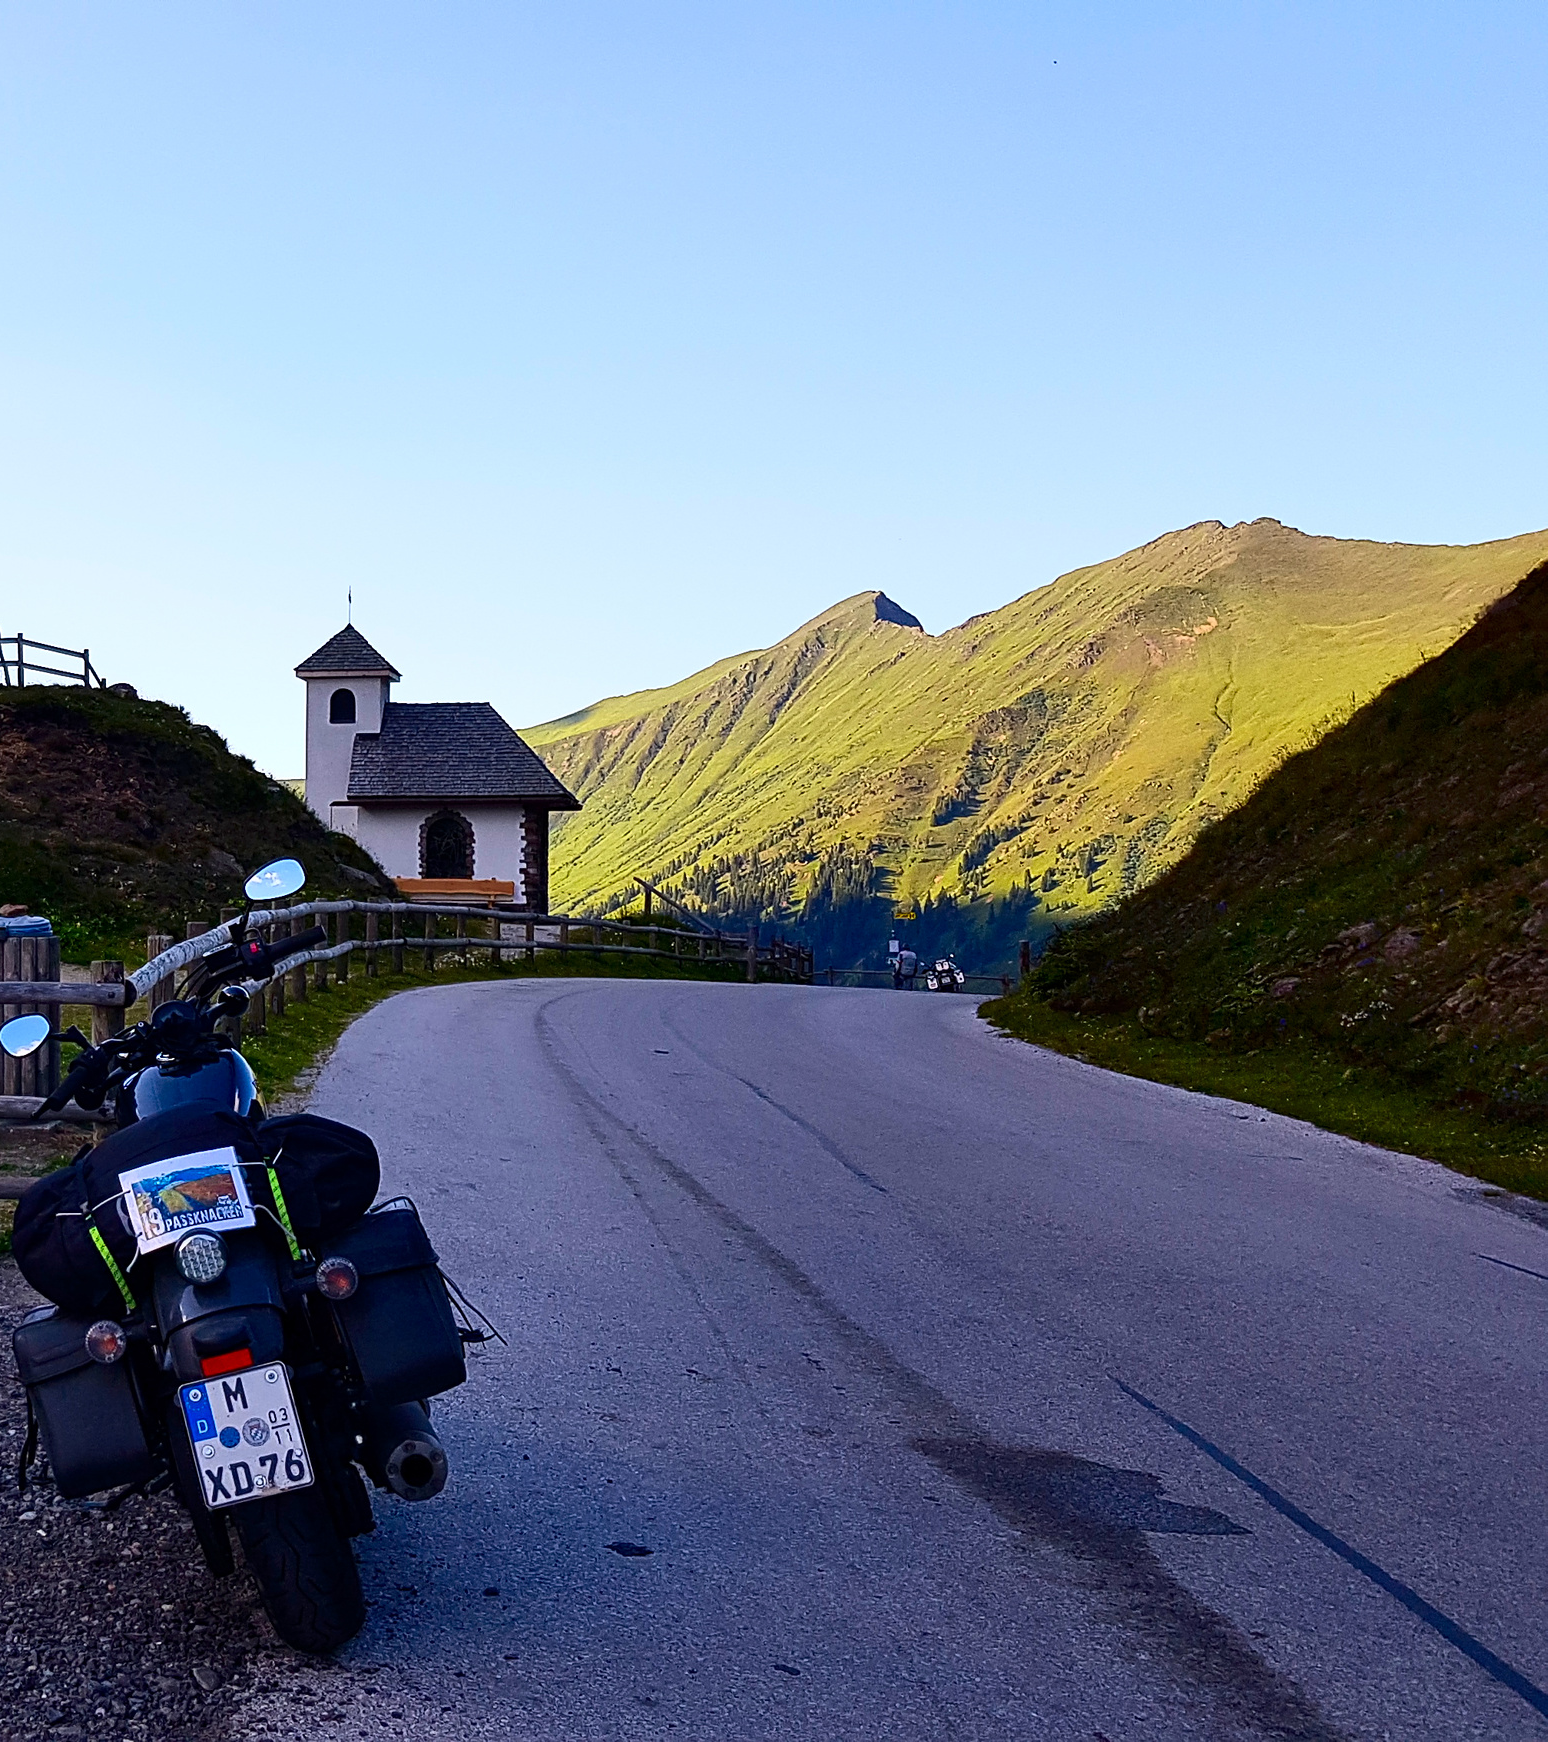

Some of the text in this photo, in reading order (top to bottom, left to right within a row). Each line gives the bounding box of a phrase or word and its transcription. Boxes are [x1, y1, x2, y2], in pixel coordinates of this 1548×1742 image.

[141, 1205, 244, 1239] 19 PASSKNACKER
[221, 1377, 249, 1413] M
[268, 1407, 289, 1424] 03
[196, 1419, 209, 1434] D
[274, 1428, 294, 1445] 11
